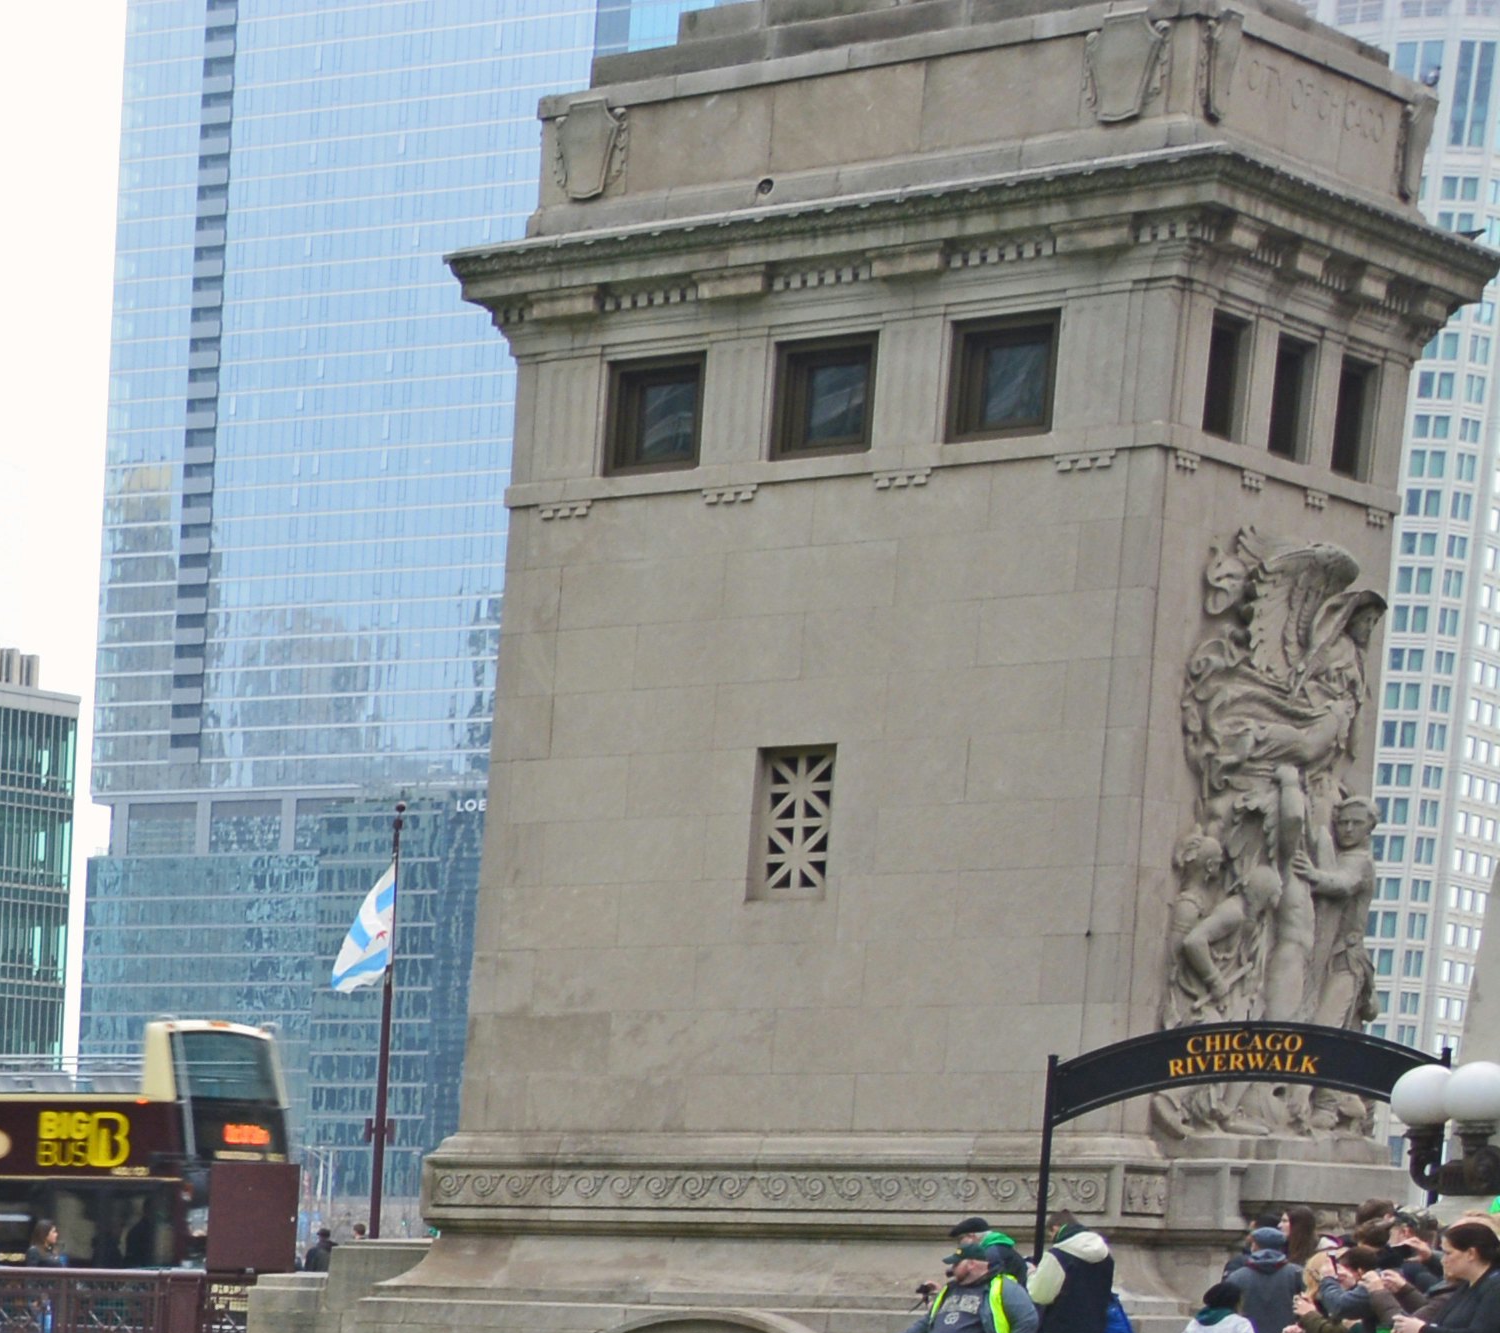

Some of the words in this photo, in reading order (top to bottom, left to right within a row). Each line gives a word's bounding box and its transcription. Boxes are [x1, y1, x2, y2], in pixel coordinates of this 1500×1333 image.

[1186, 1032, 1304, 1055] CHICAGO
[1168, 1053, 1321, 1079] RIVERWALK
[38, 1111, 89, 1140] BIG
[36, 1141, 88, 1167] BUS
